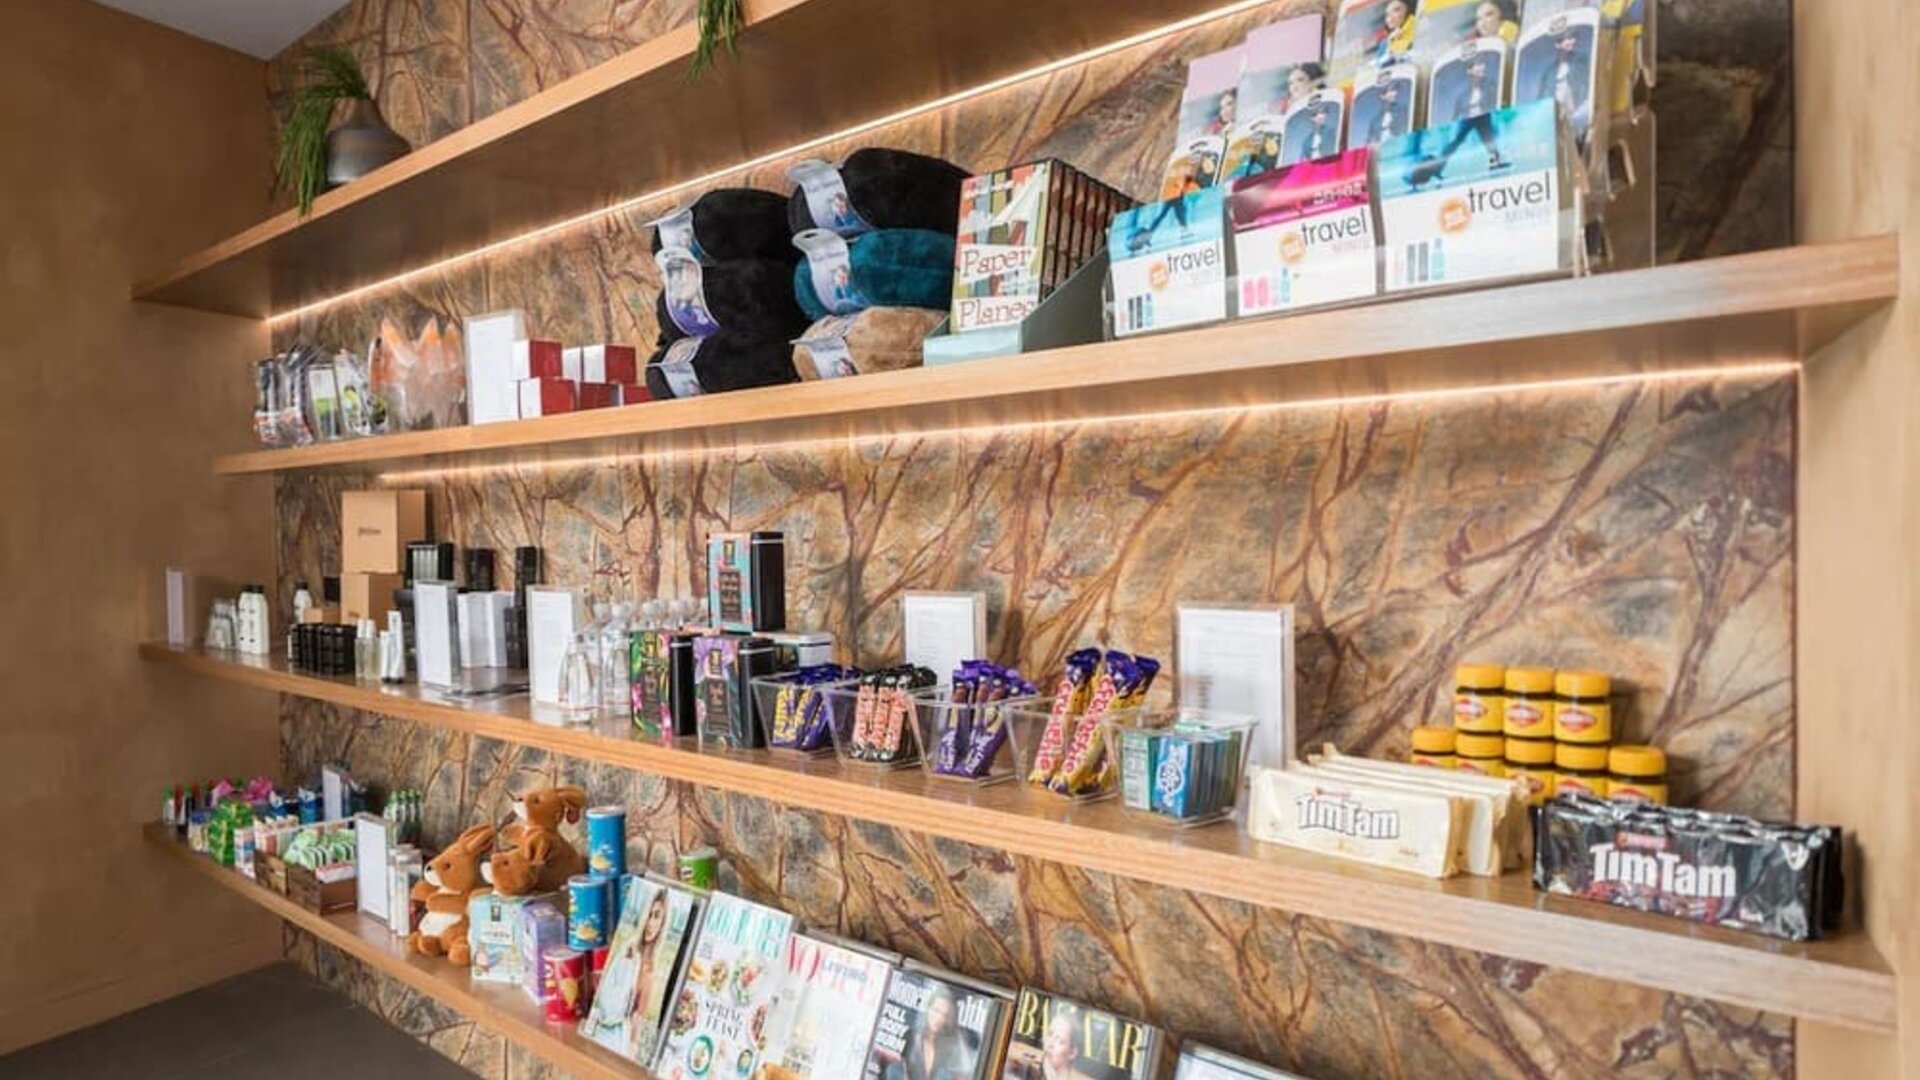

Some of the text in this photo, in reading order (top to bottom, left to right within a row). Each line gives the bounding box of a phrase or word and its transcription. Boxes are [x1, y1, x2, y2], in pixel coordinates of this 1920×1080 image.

[1467, 171, 1551, 213] travel
[1301, 207, 1368, 246] travel
[963, 249, 1032, 278] Paper
[1167, 239, 1221, 274] travel
